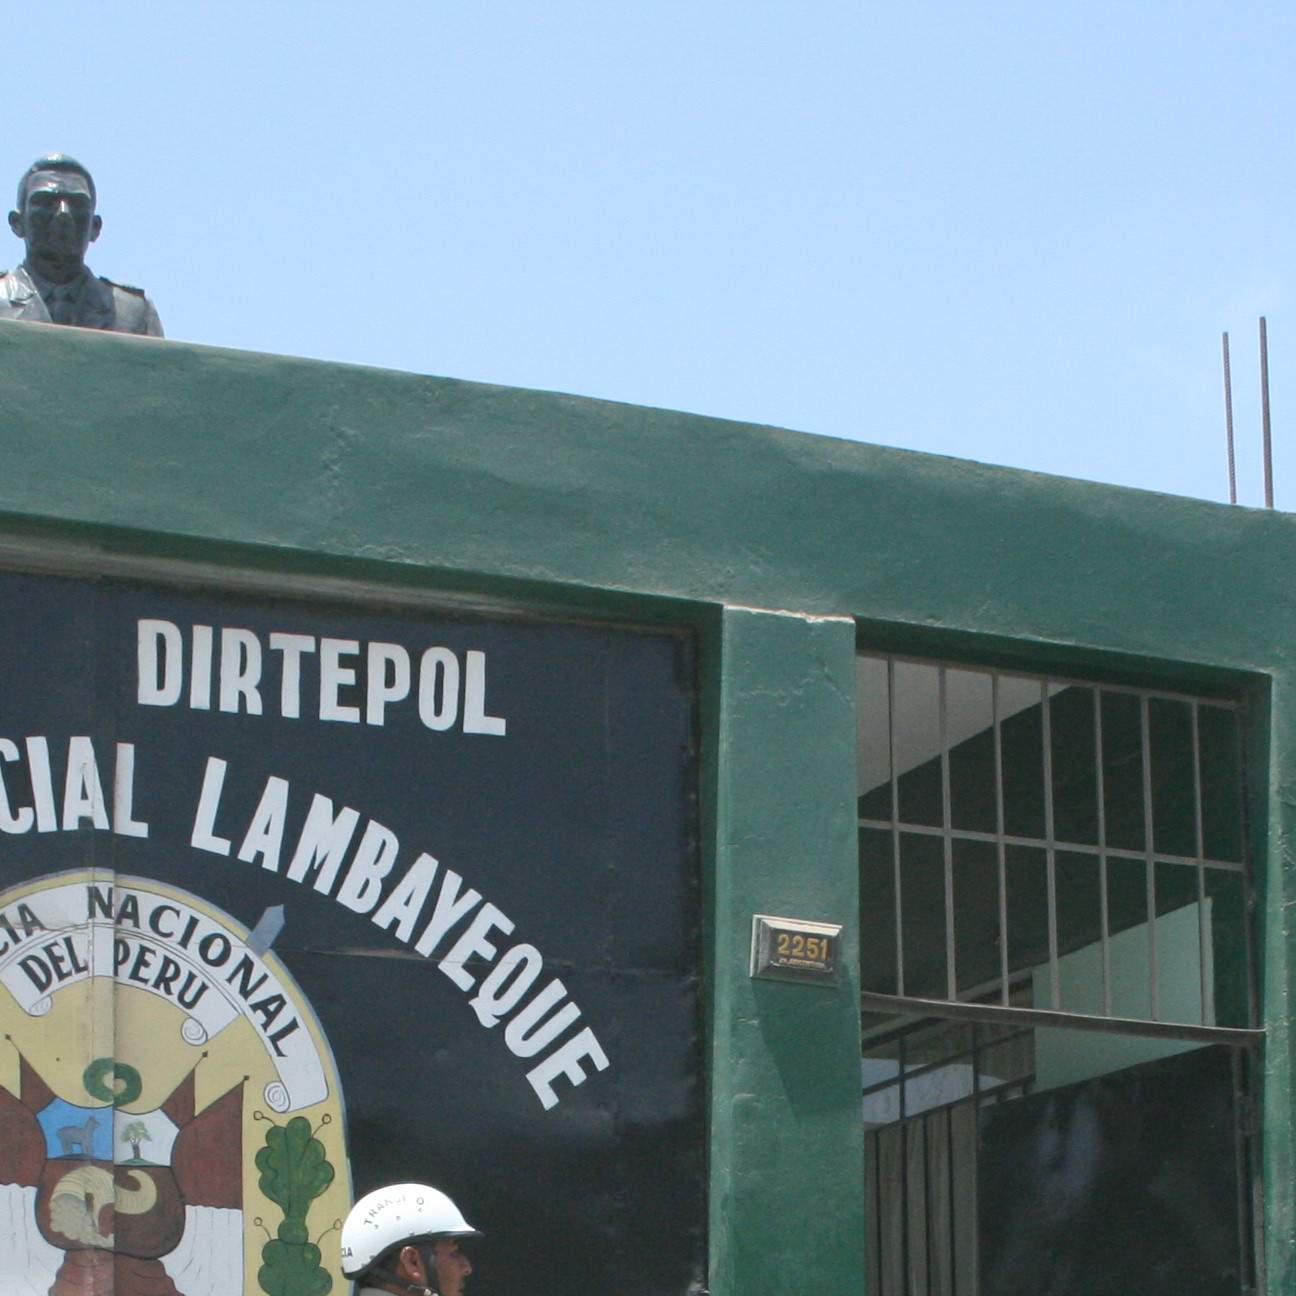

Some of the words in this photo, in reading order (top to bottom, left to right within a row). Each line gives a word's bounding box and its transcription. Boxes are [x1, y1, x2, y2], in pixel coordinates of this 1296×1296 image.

[137, 619, 506, 737] DIRTEPOL
[17, 936, 90, 995] DEL
[113, 937, 210, 1010] PERU
[86, 886, 301, 1059] NACIONAL
[190, 756, 610, 1111] LAMBAYEQUE
[777, 933, 829, 961] 2251
